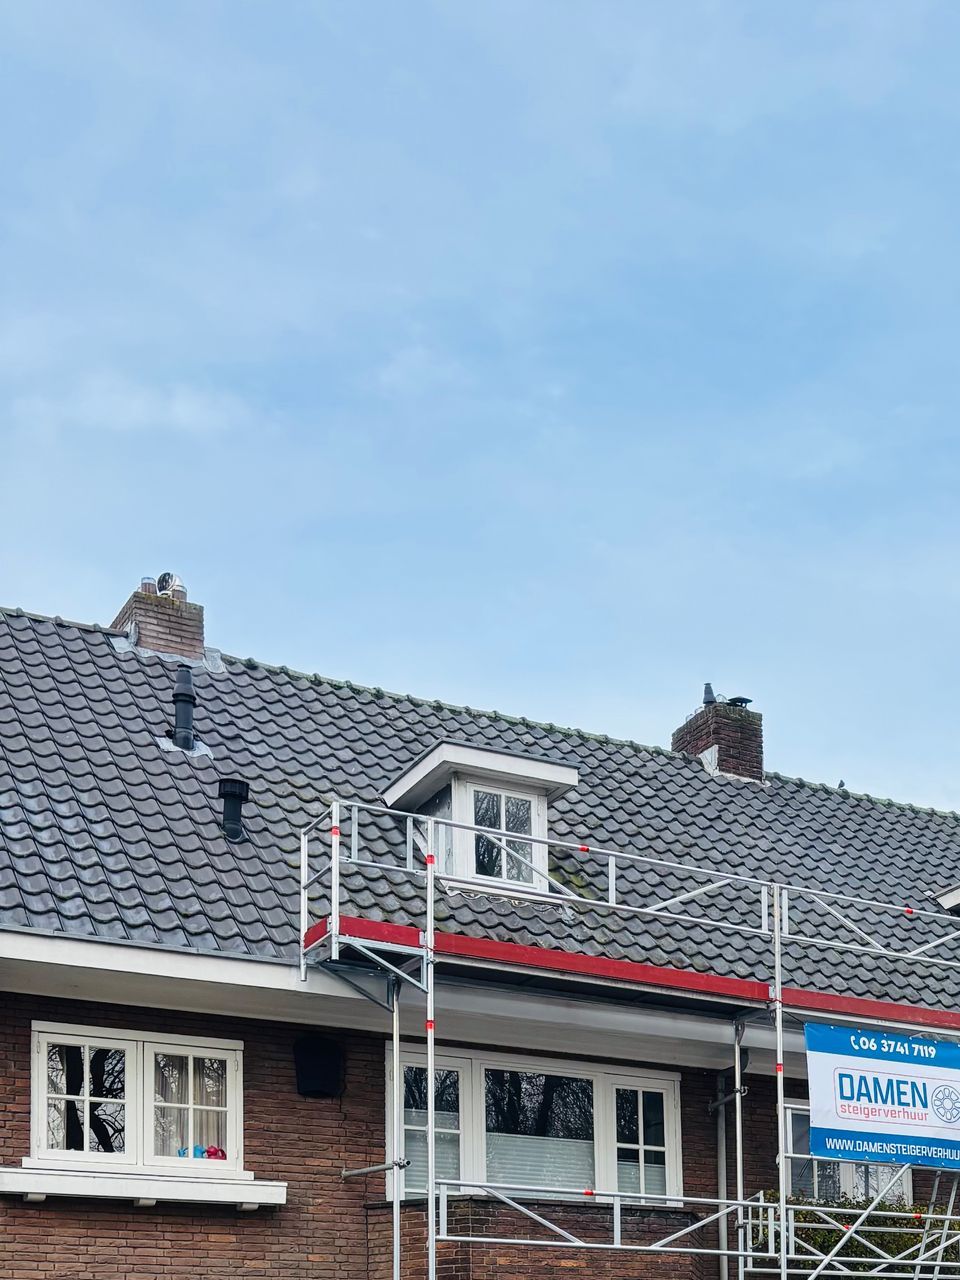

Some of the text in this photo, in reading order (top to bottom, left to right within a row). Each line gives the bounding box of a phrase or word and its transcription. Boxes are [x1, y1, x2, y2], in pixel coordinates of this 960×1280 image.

[860, 1037, 936, 1058] 06 3741 7119
[838, 1073, 929, 1109] DAMEN
[840, 1103, 929, 1121] steigerverhuur
